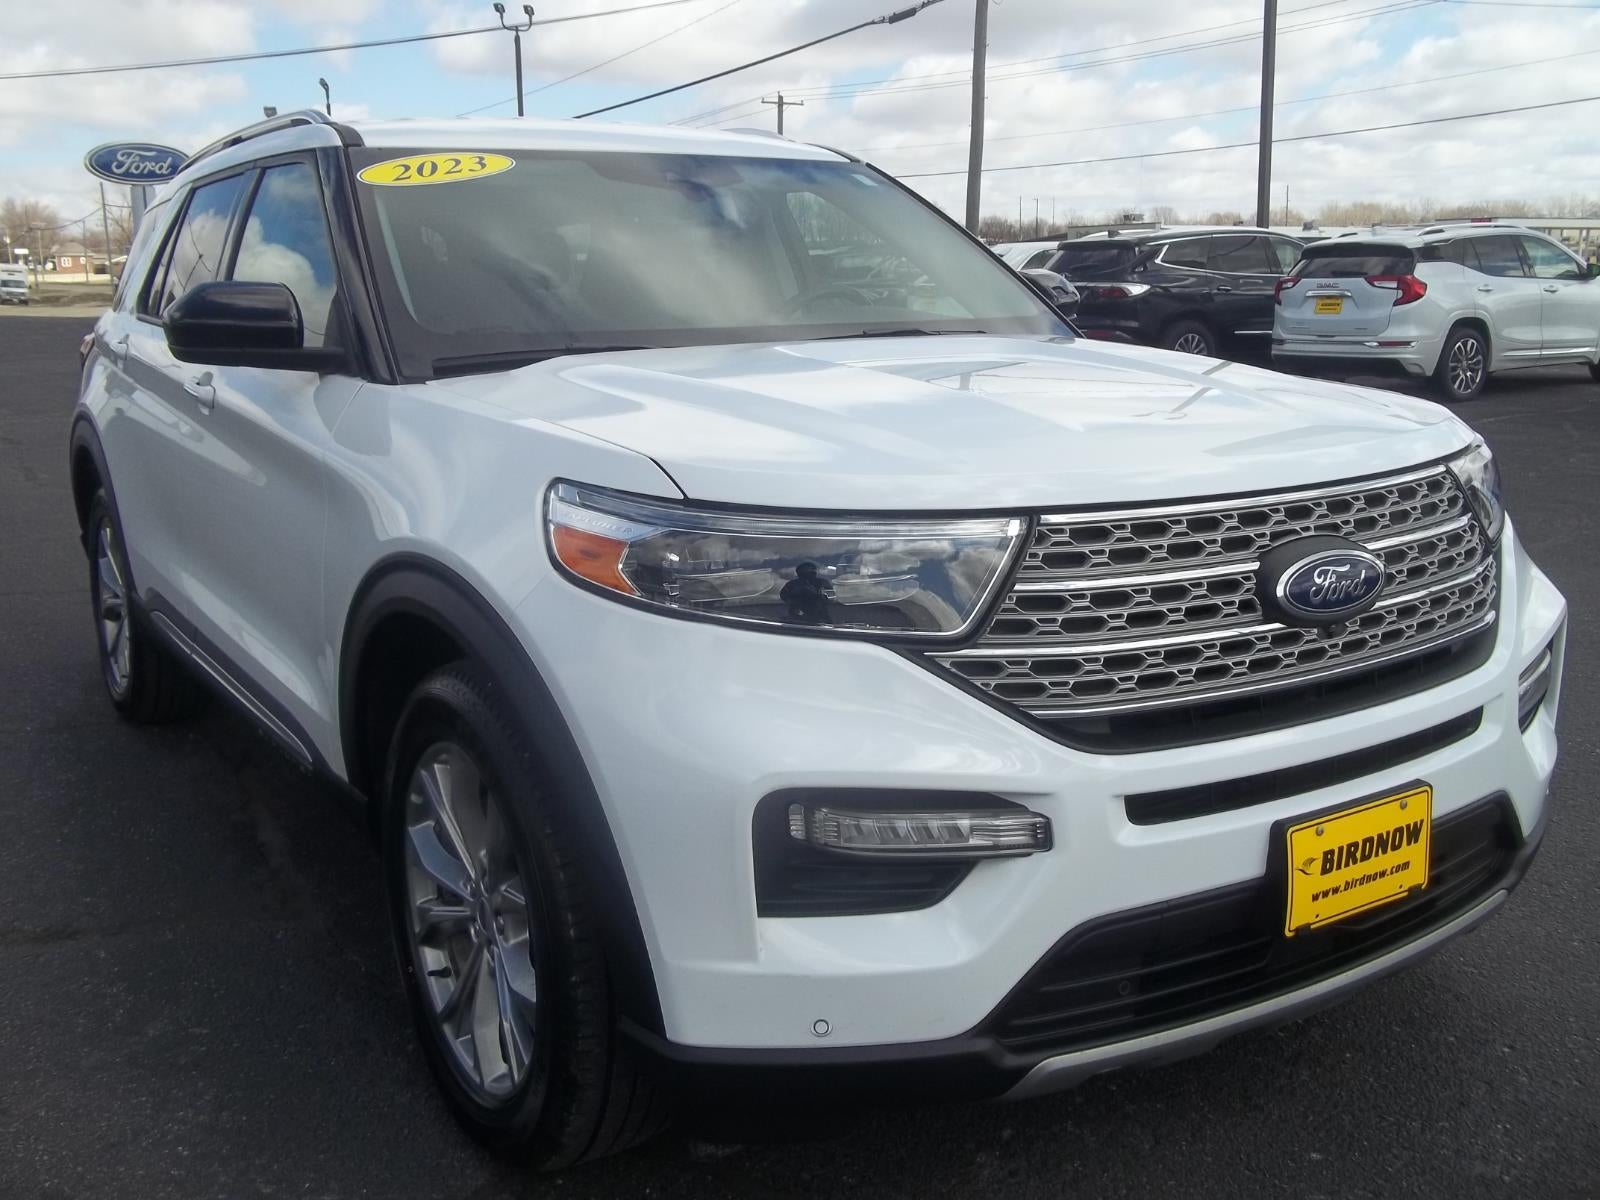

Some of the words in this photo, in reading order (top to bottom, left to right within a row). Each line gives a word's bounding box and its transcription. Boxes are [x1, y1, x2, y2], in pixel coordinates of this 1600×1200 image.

[111, 149, 172, 175] Ford
[392, 155, 487, 182] 2023
[1310, 563, 1366, 601] Ford
[1320, 819, 1424, 876] BIRDNOW
[1311, 860, 1410, 903] www.birdnow.com
